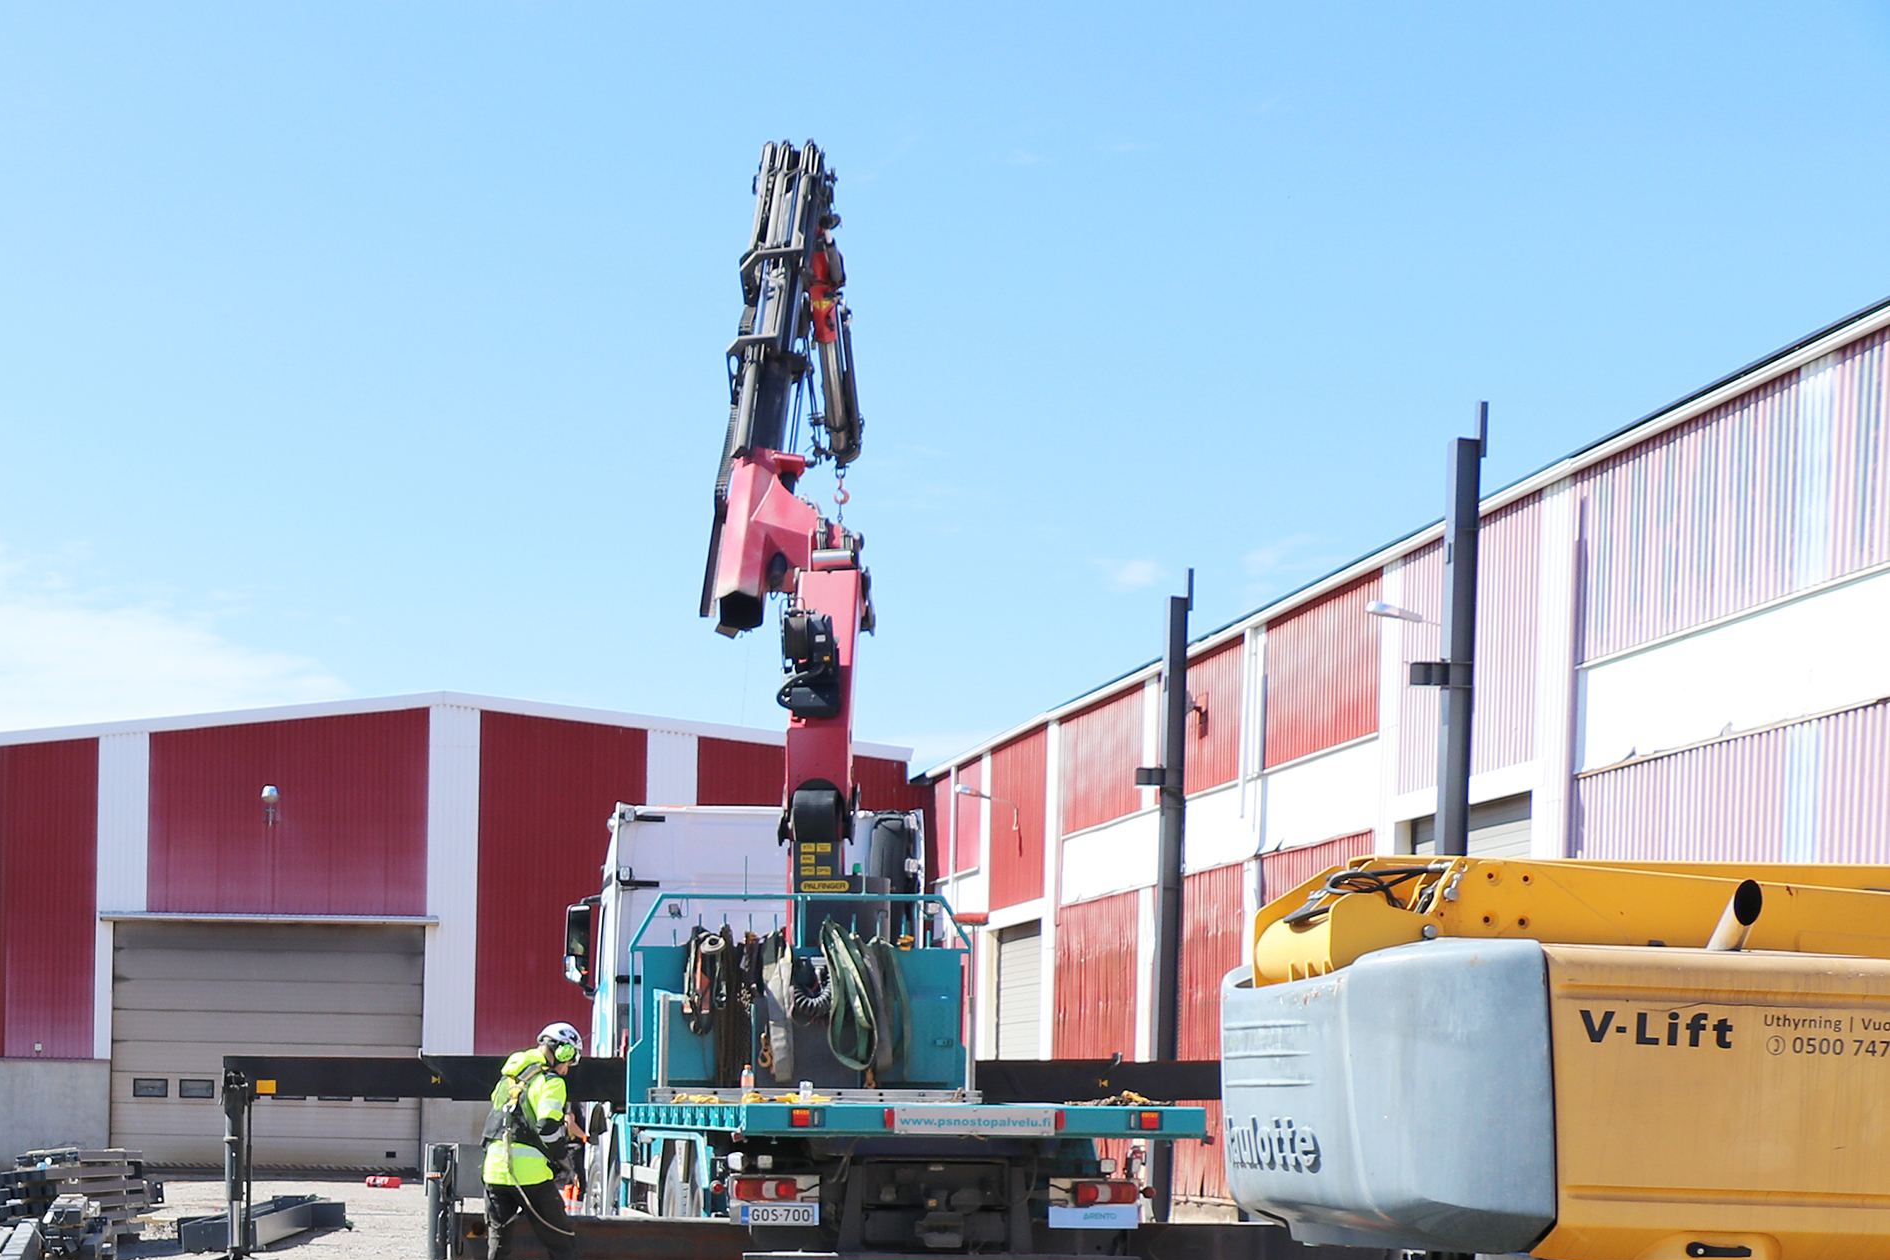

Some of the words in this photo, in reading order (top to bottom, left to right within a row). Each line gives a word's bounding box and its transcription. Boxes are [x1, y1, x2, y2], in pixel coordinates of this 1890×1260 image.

[803, 881, 846, 890] PALFINGER
[1579, 1009, 1733, 1049] V-Lift
[1764, 1014, 1842, 1032] Uthyrning
[1792, 1036, 1844, 1055] 0500
[1852, 1039, 1890, 1057] 747
[899, 1116, 1051, 1128] www.psnostopalvelu.fi
[752, 1208, 810, 1222] GOS-700
[1083, 1212, 1117, 1220] ARENTO
